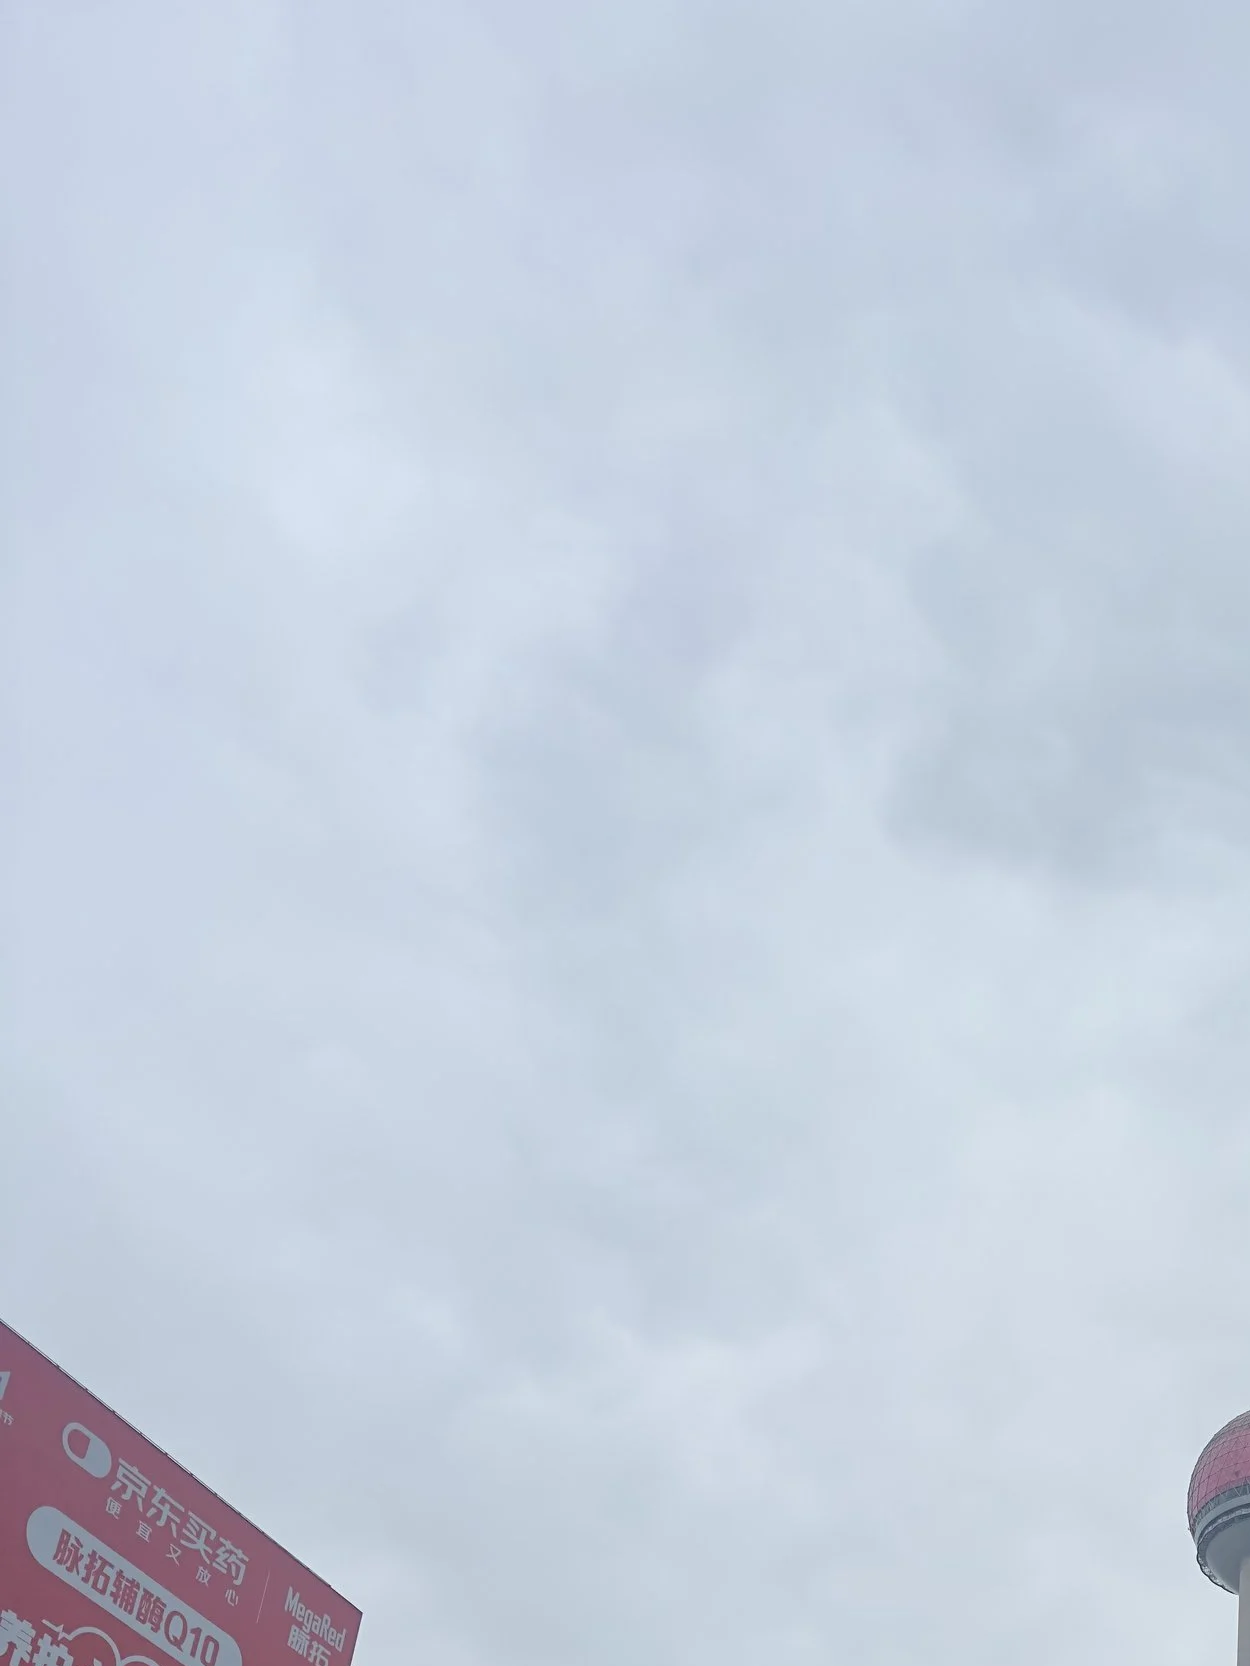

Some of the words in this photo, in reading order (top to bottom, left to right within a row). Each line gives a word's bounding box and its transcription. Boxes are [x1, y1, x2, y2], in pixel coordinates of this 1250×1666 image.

[105, 1496, 239, 1607] 便宜又放心
[112, 1457, 249, 1587] 京东买药
[285, 1585, 347, 1654] MegaRed
